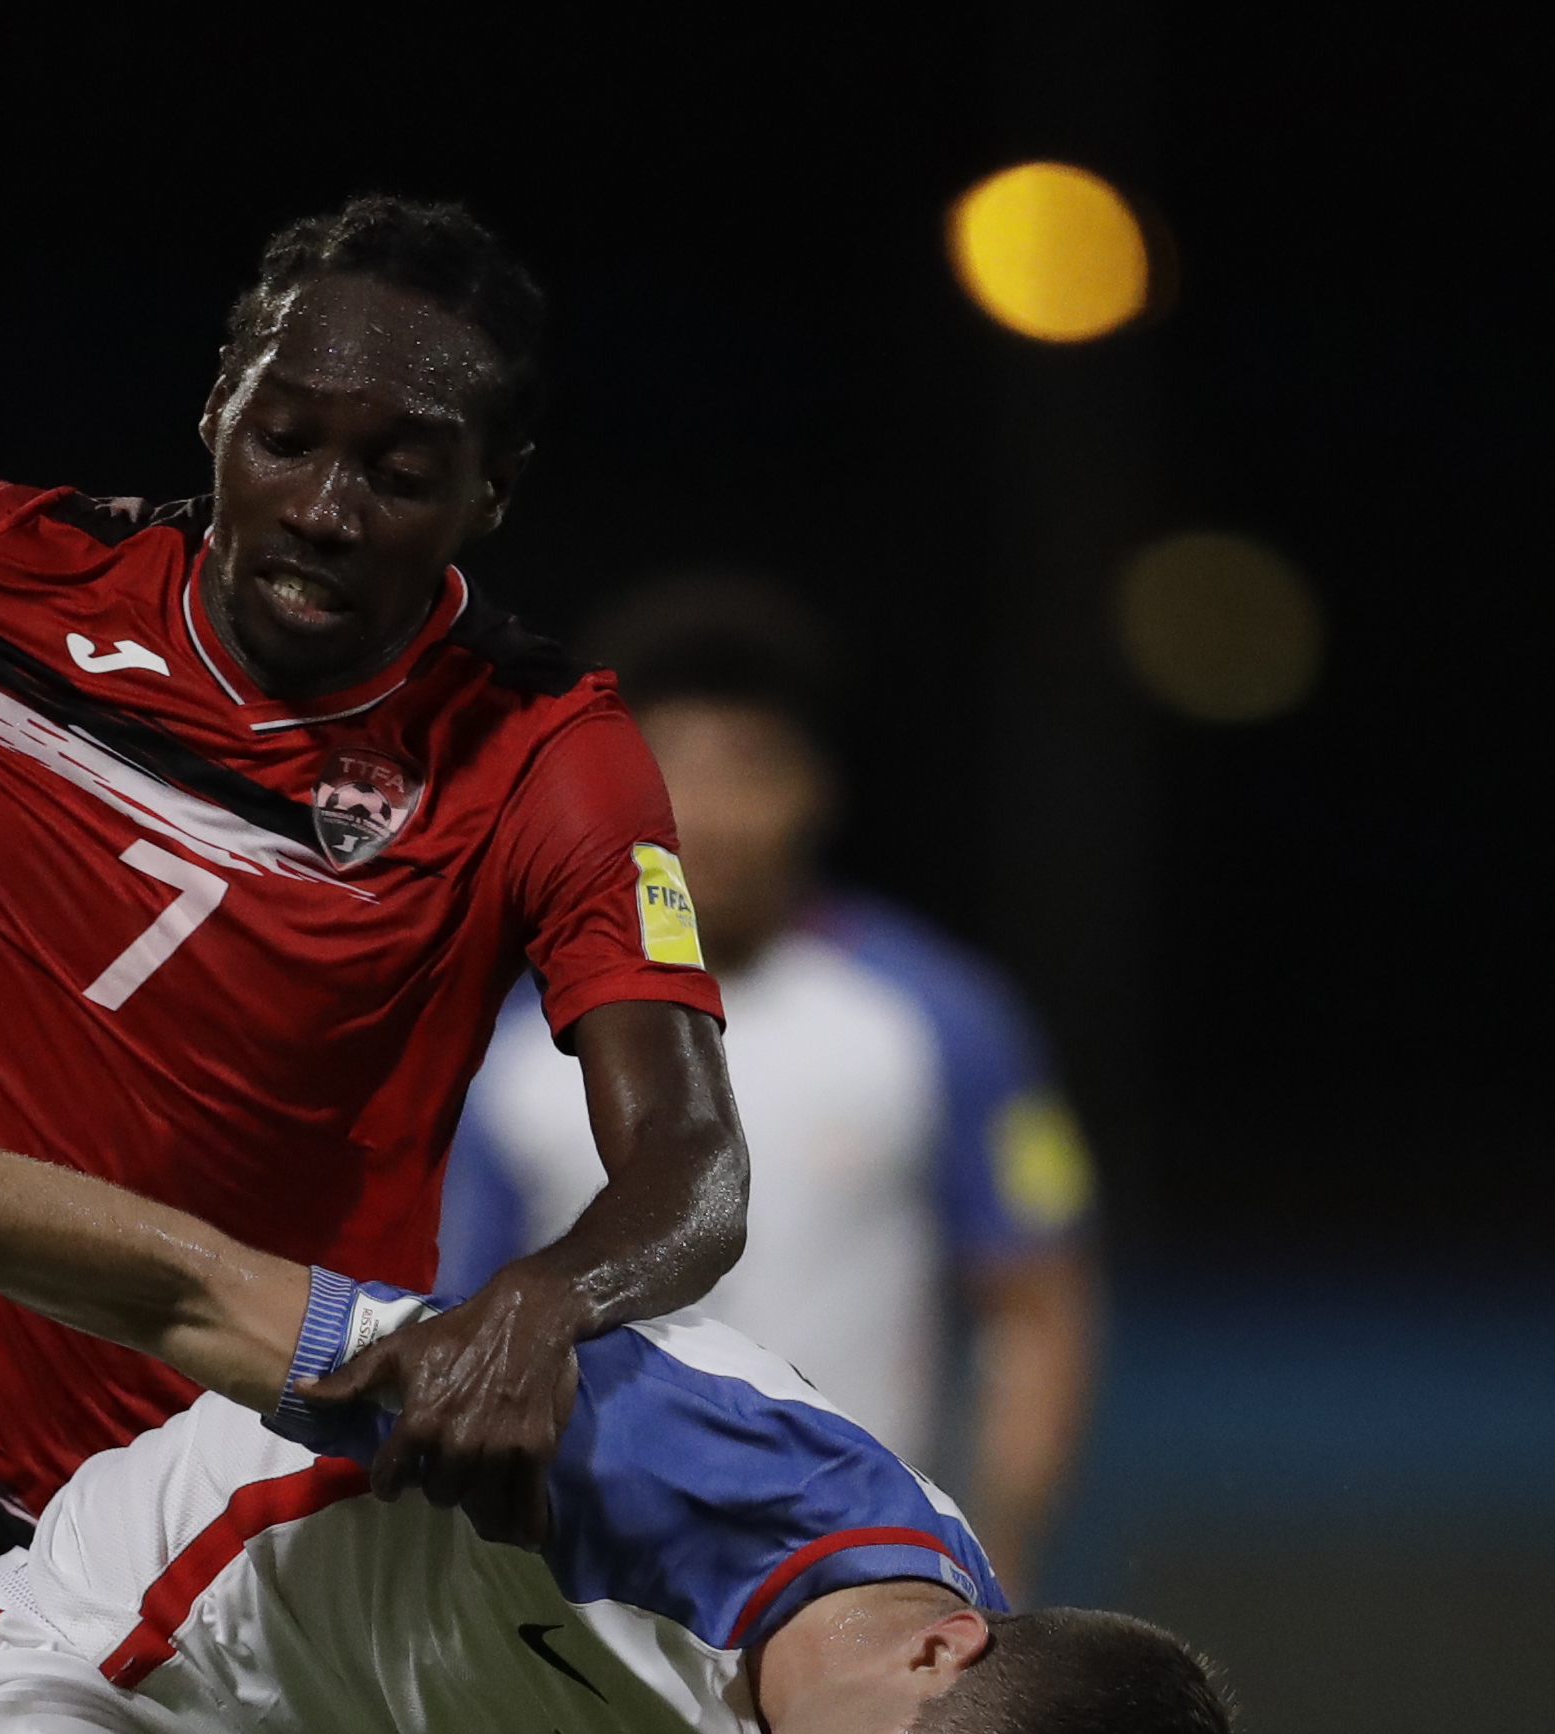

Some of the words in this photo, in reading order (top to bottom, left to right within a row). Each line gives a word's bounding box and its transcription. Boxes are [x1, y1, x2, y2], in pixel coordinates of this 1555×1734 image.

[339, 757, 405, 794] TTFA
[646, 885, 693, 913] FIFA
[81, 838, 230, 1012] 7
[356, 1306, 374, 1349] RUSSIA
